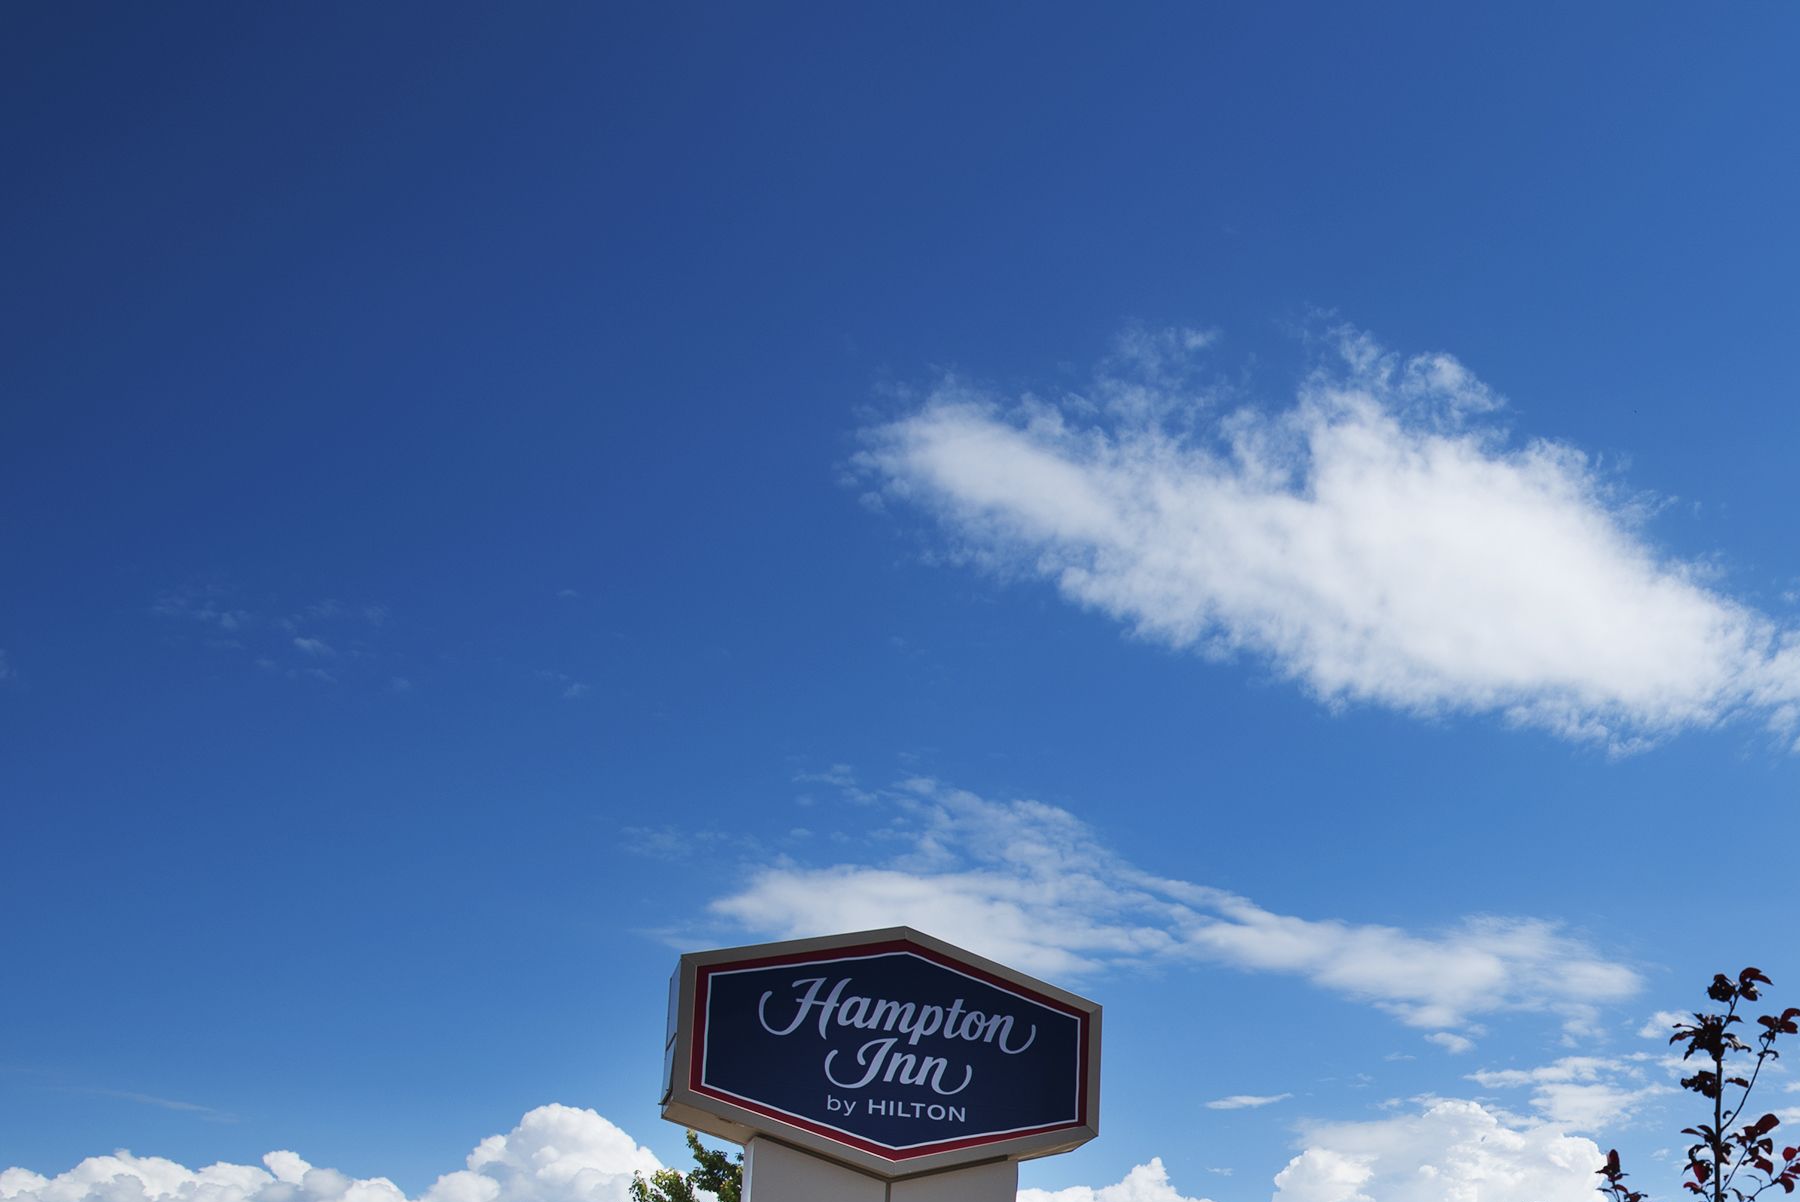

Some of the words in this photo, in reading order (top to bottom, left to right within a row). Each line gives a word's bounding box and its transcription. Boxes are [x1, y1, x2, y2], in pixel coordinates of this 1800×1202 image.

[758, 977, 1037, 1055] Hampton
[824, 1037, 973, 1095] Inn
[826, 1095, 857, 1117] by
[867, 1098, 966, 1122] HILTON
